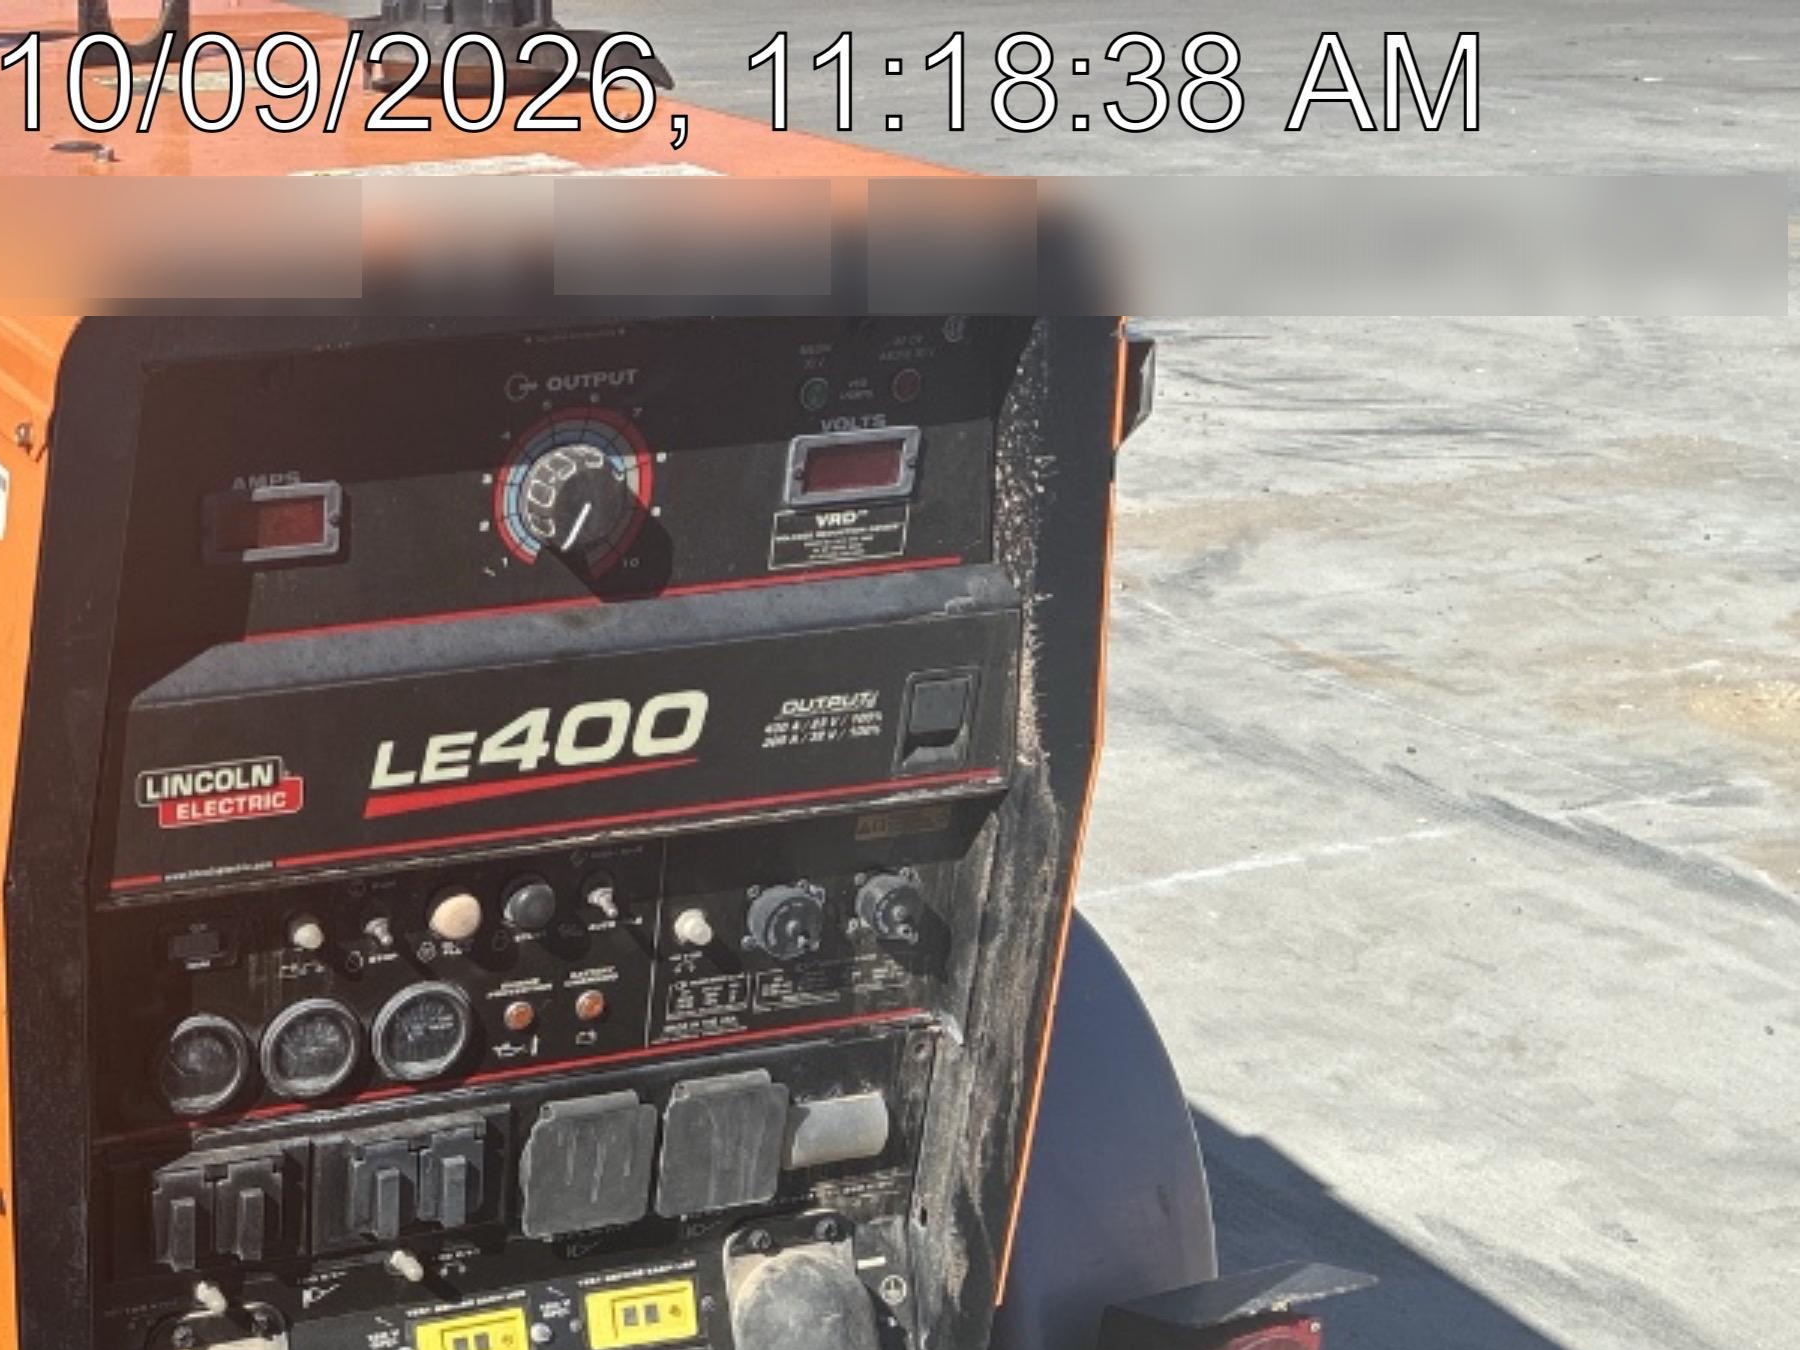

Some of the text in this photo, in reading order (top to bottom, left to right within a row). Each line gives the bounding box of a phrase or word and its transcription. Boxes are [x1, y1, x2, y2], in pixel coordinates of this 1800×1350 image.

[546, 369, 637, 390] OUTPUT
[369, 689, 710, 790] LE400
[146, 763, 274, 800] LINCOLN
[175, 790, 288, 821] ELECTRIC
